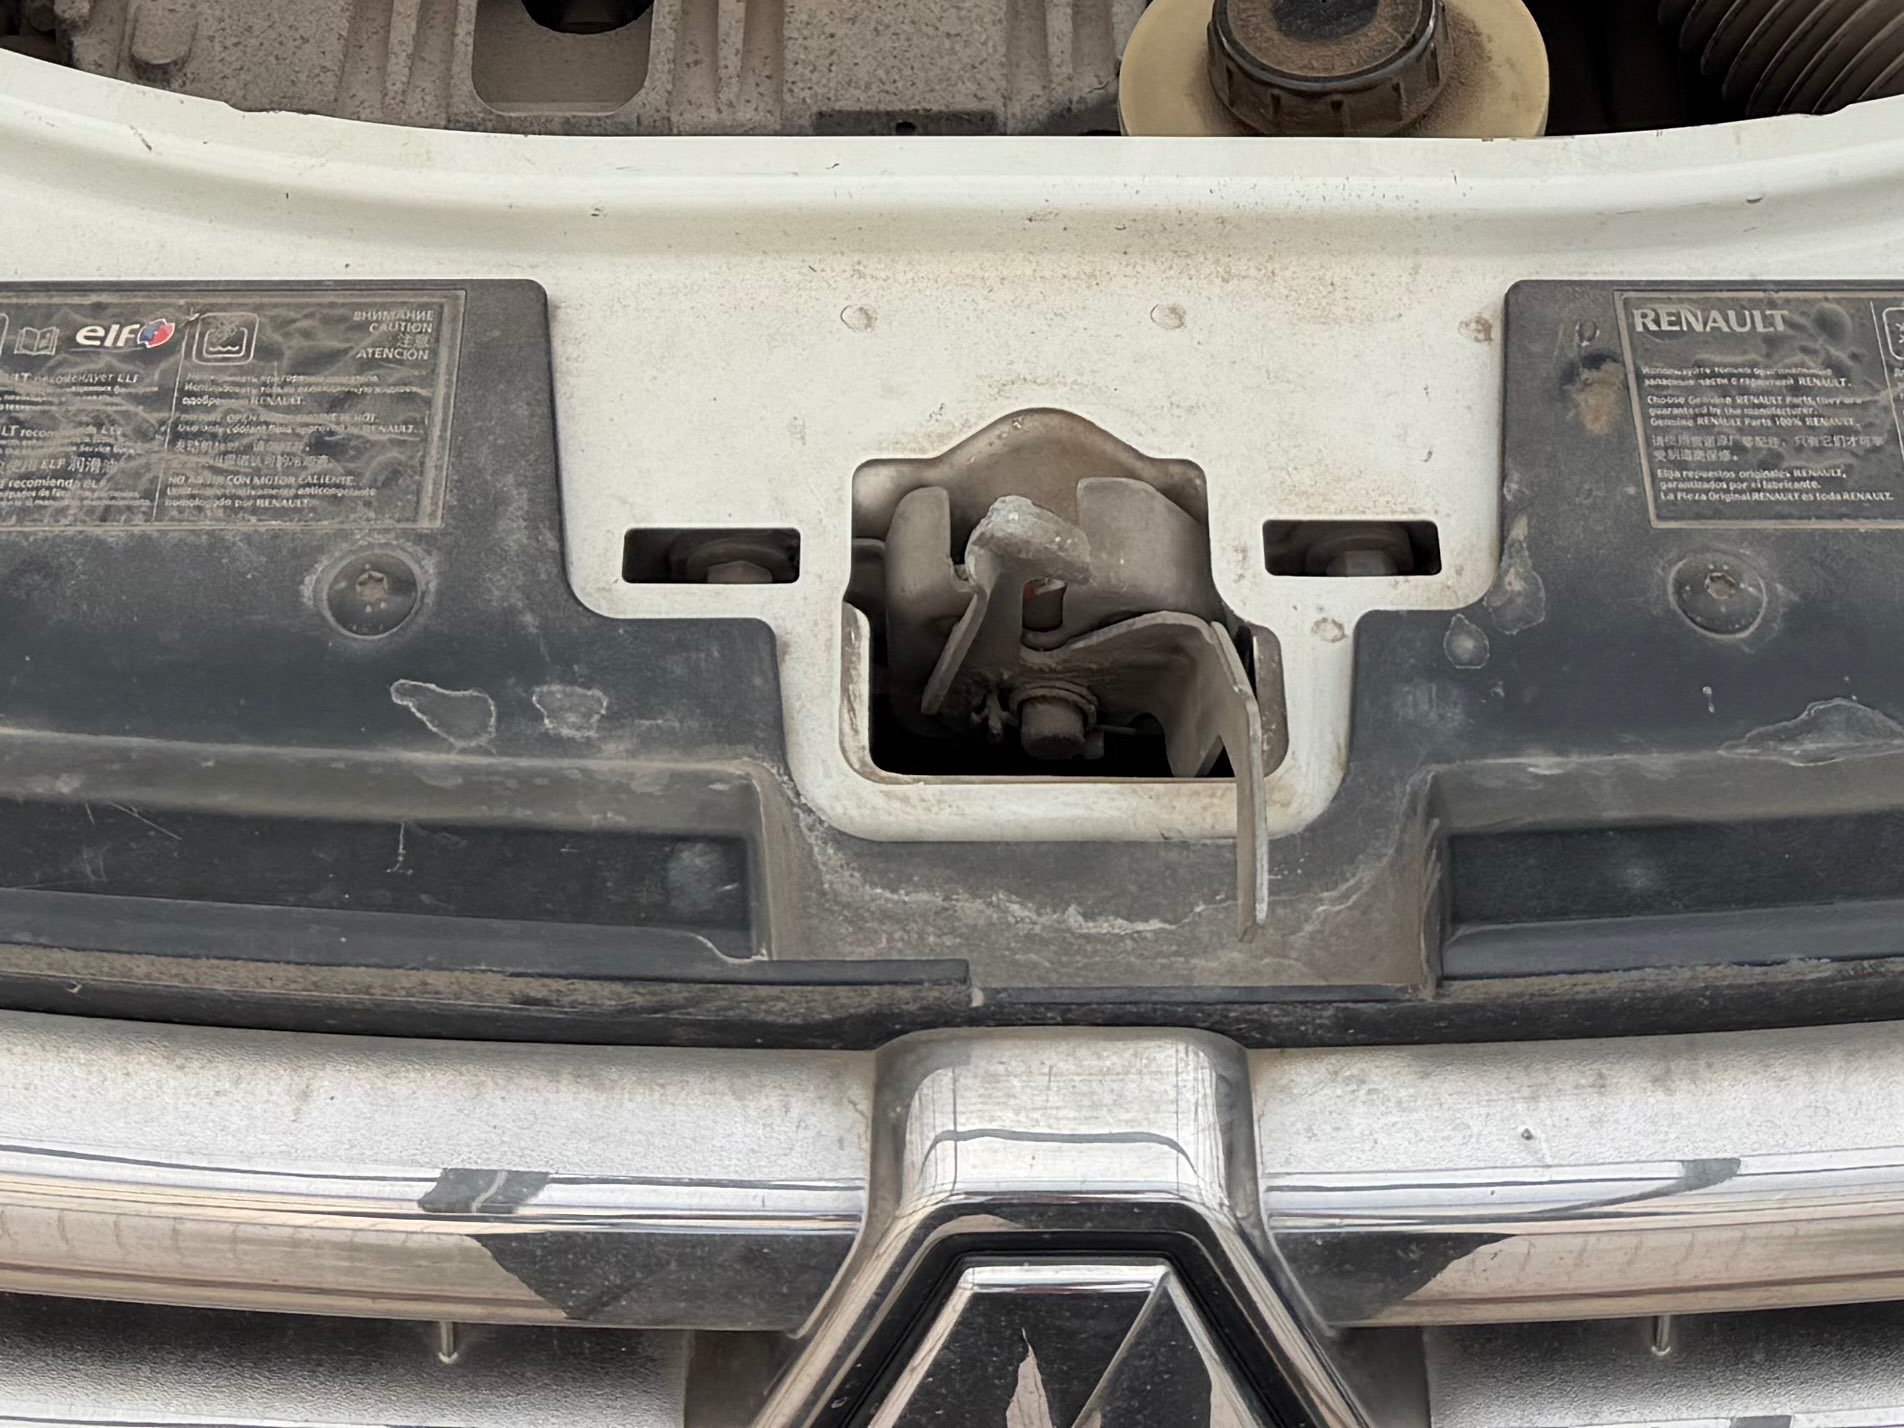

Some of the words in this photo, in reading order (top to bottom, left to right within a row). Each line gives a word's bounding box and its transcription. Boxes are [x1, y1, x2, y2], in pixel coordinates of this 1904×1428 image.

[369, 322, 433, 334] CAUTION
[1632, 308, 1789, 332] RENAULT
[75, 323, 141, 347] elf
[356, 347, 428, 360] ATENCIÓN
